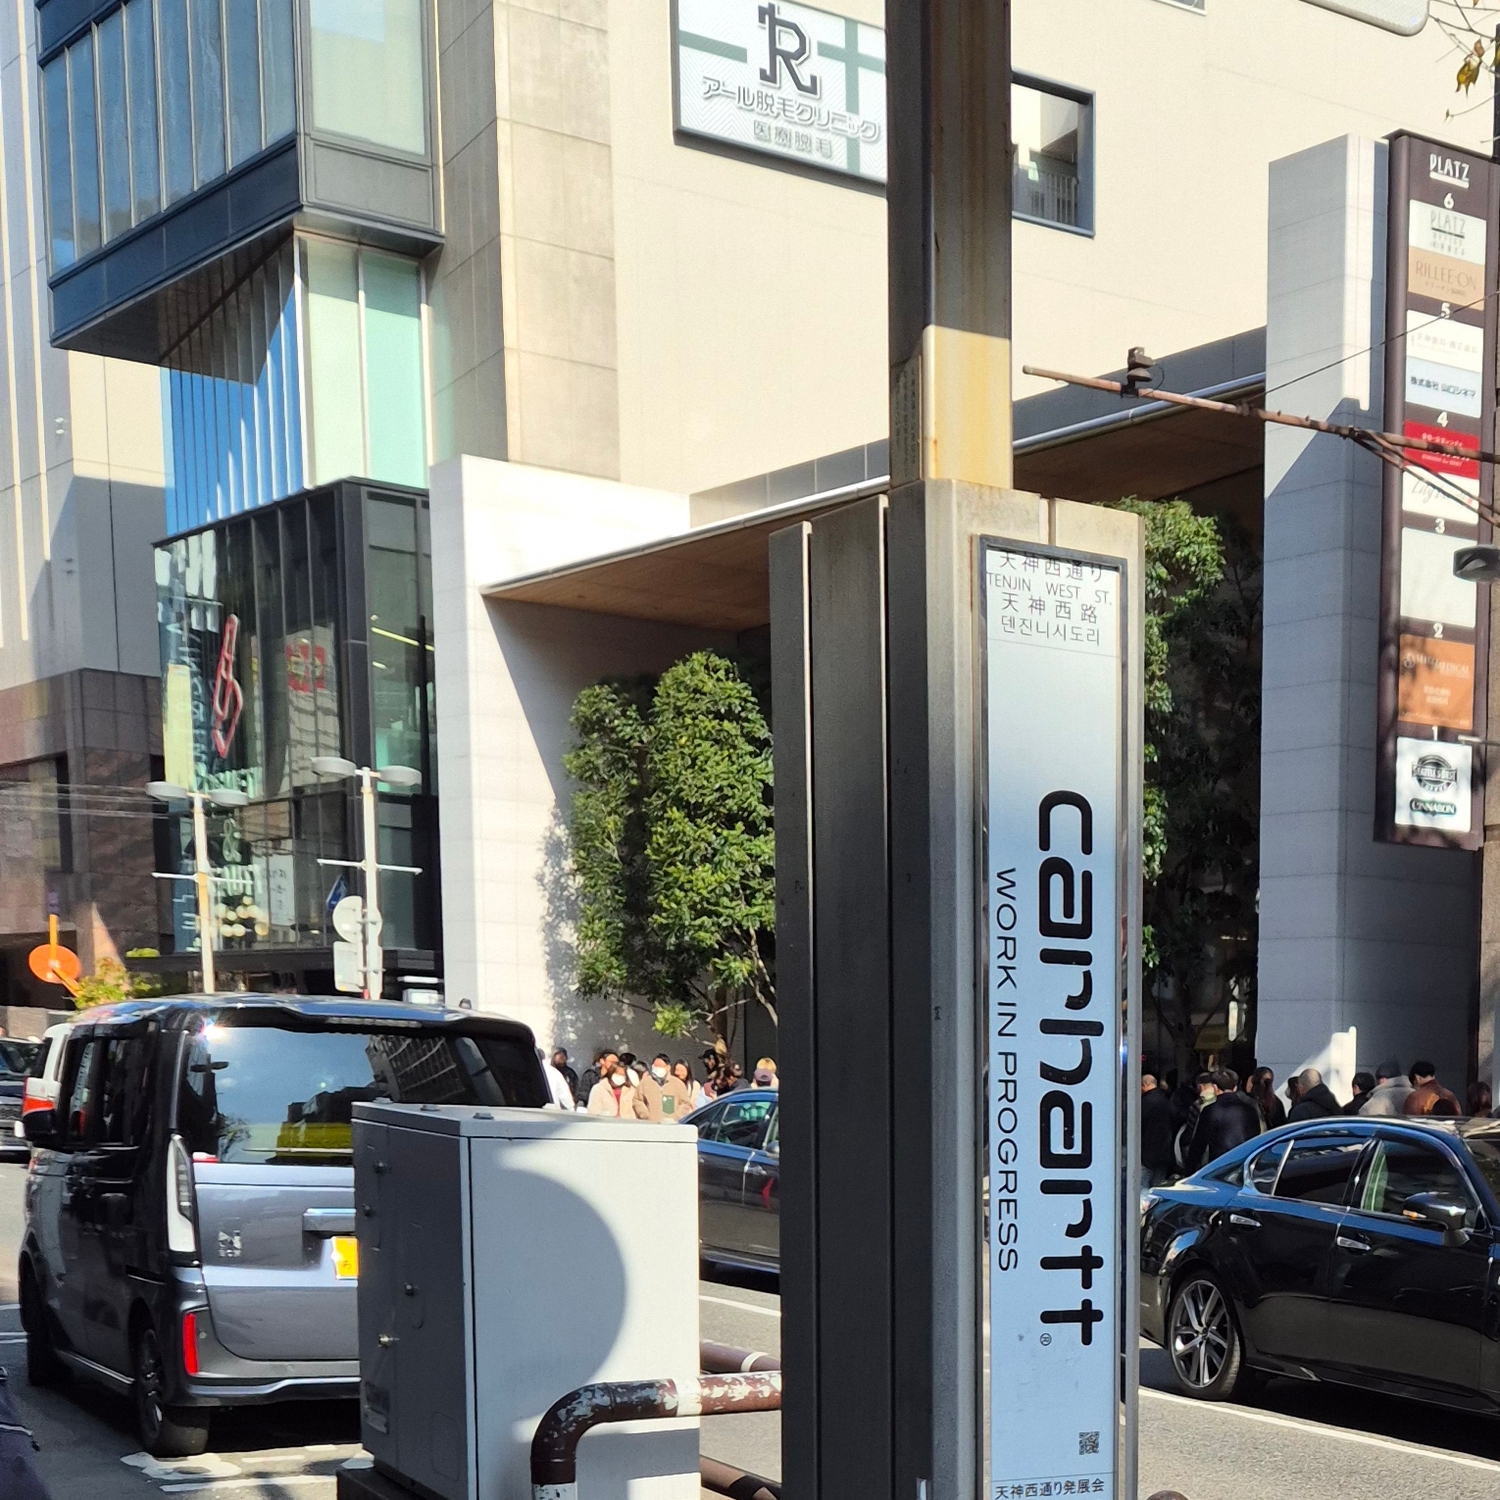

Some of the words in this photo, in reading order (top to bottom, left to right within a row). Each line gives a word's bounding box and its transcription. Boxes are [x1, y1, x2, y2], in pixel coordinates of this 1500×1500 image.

[703, 76, 880, 142] アール脱毛クリニック
[754, 120, 832, 158] 医療脱毛
[1430, 153, 1470, 182] PLATZ
[1444, 193, 1454, 209] 6
[1441, 302, 1451, 319] 5
[1437, 411, 1448, 427] 4
[1435, 518, 1445, 534] 3
[987, 572, 1032, 592] TENJIN
[1046, 582, 1081, 600] WEST
[1095, 589, 1113, 606] ST.
[1001, 591, 1098, 625] 天神西路
[1001, 615, 1100, 646] 덴진니시도리
[1433, 622, 1443, 639] 2
[996, 867, 1018, 990] WORK
[997, 1002, 1018, 1038] IN
[1038, 790, 1105, 1346] carhartt
[997, 1051, 1020, 1272] PROGRESS
[995, 1477, 1105, 1500] 天神西通り発展会
